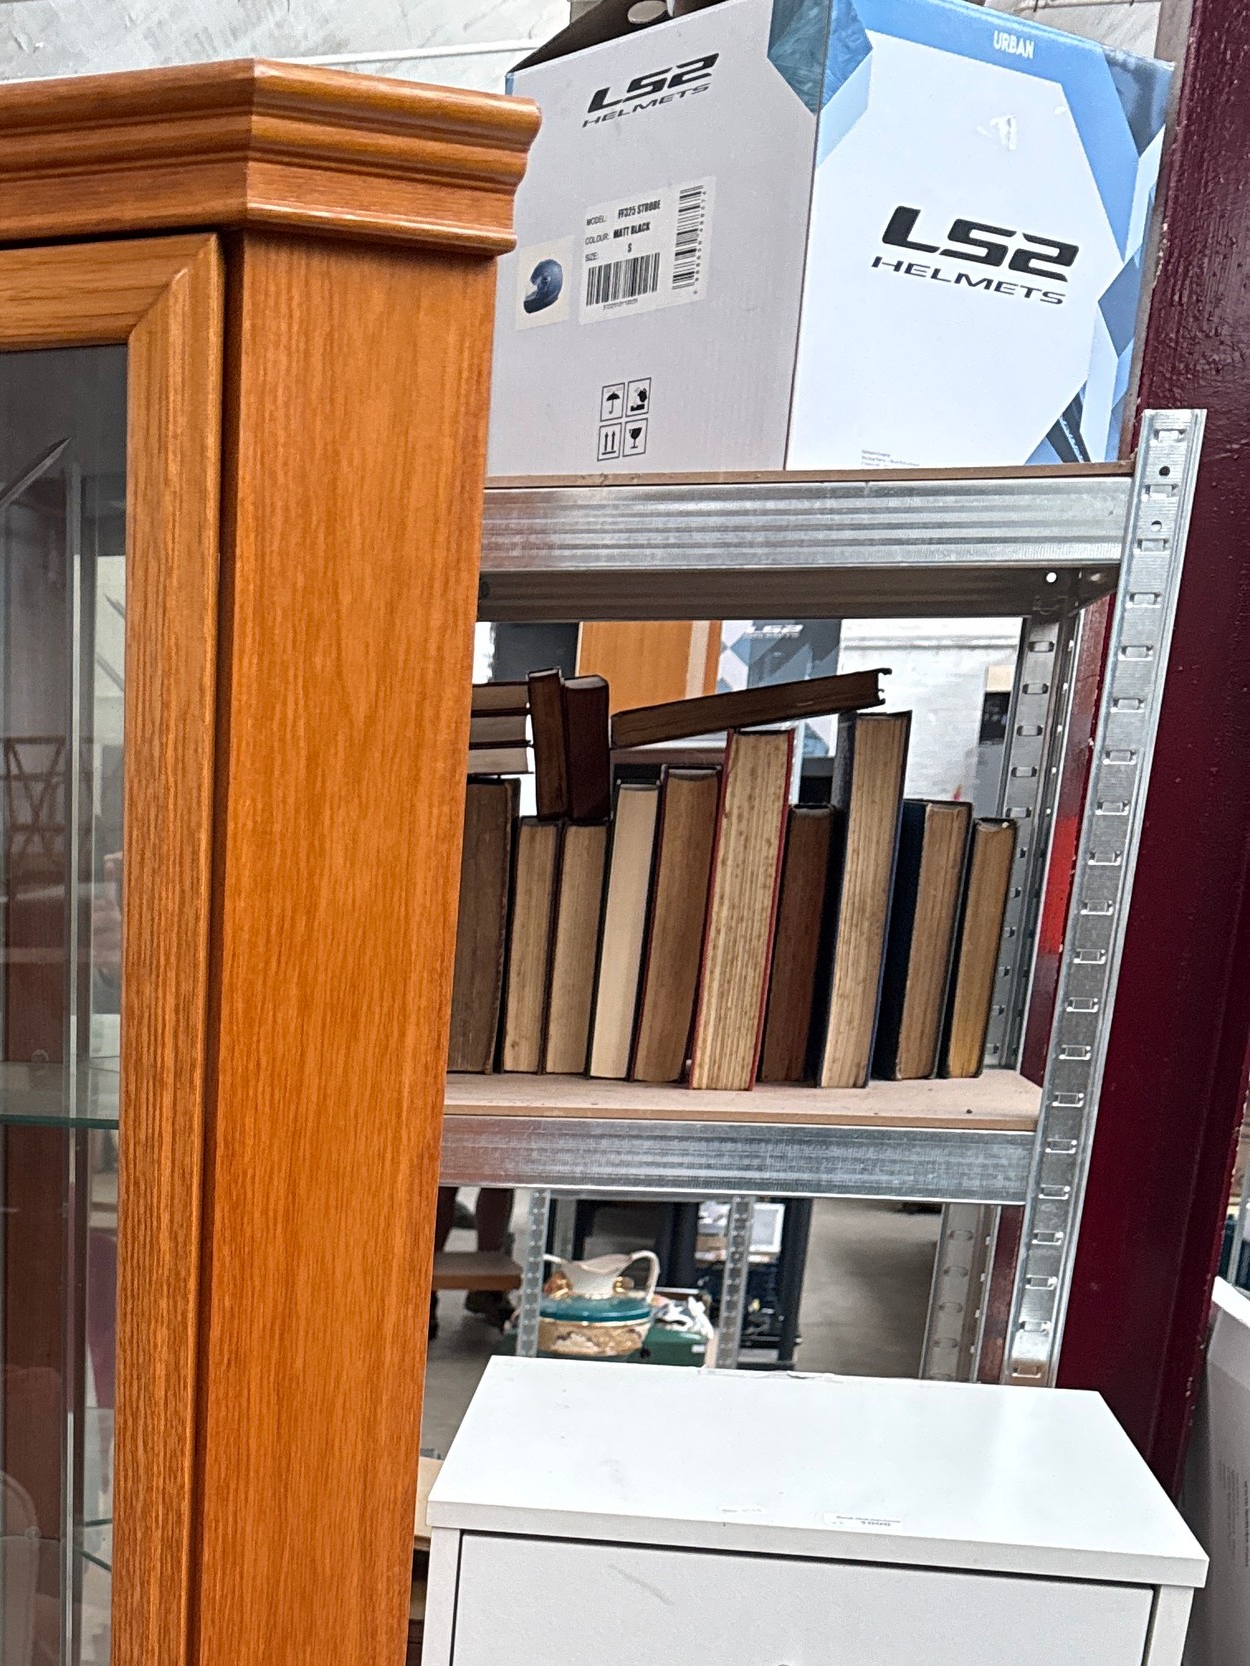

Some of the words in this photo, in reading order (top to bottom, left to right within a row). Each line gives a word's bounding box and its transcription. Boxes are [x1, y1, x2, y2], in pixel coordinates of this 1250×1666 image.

[993, 30, 1034, 59] URBAN
[587, 53, 719, 113] LS2
[582, 83, 710, 128] HELMETS
[637, 200, 661, 215] STROBE
[613, 226, 630, 239] MATT
[630, 222, 651, 235] BLACK
[627, 243, 632, 253] S
[882, 205, 1079, 282] LS2
[871, 256, 1066, 305] HELMETS
